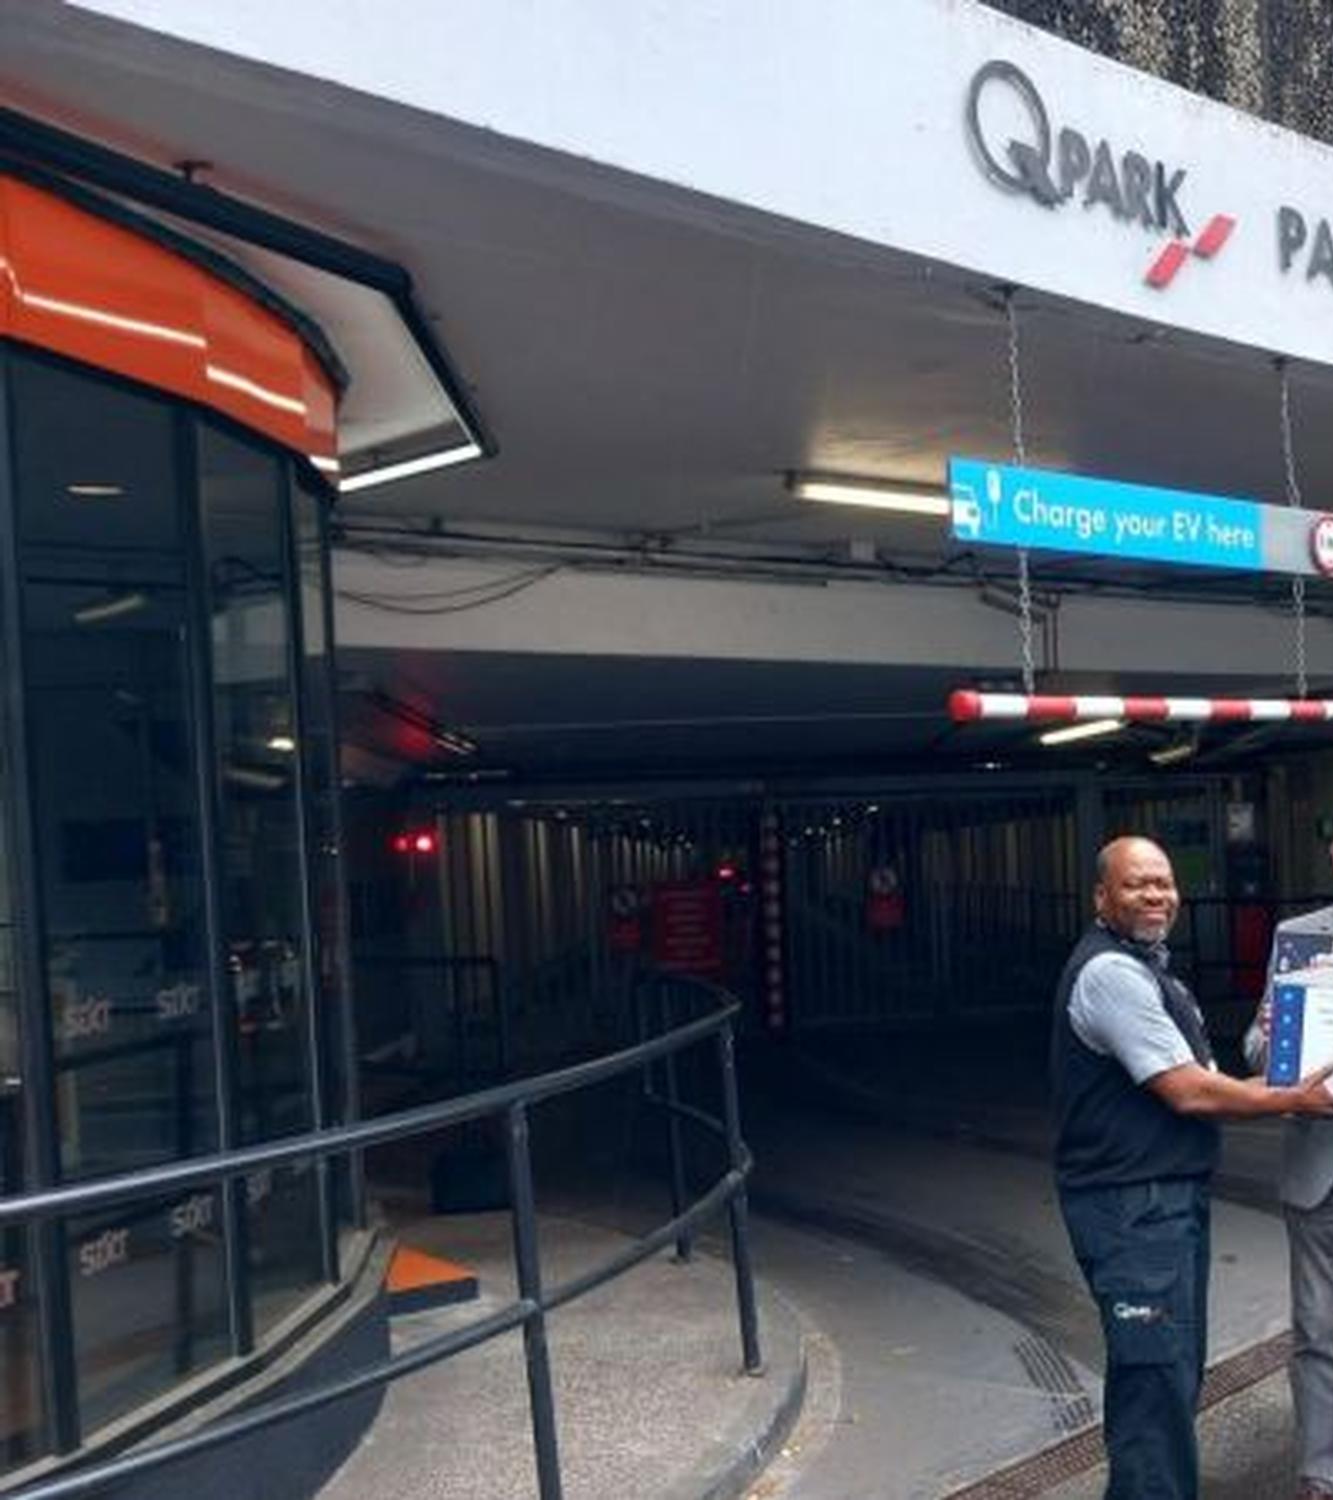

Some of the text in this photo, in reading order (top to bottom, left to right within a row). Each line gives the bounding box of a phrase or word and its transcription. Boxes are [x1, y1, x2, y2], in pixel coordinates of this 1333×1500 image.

[1012, 488, 1256, 549] Charge your EV here
